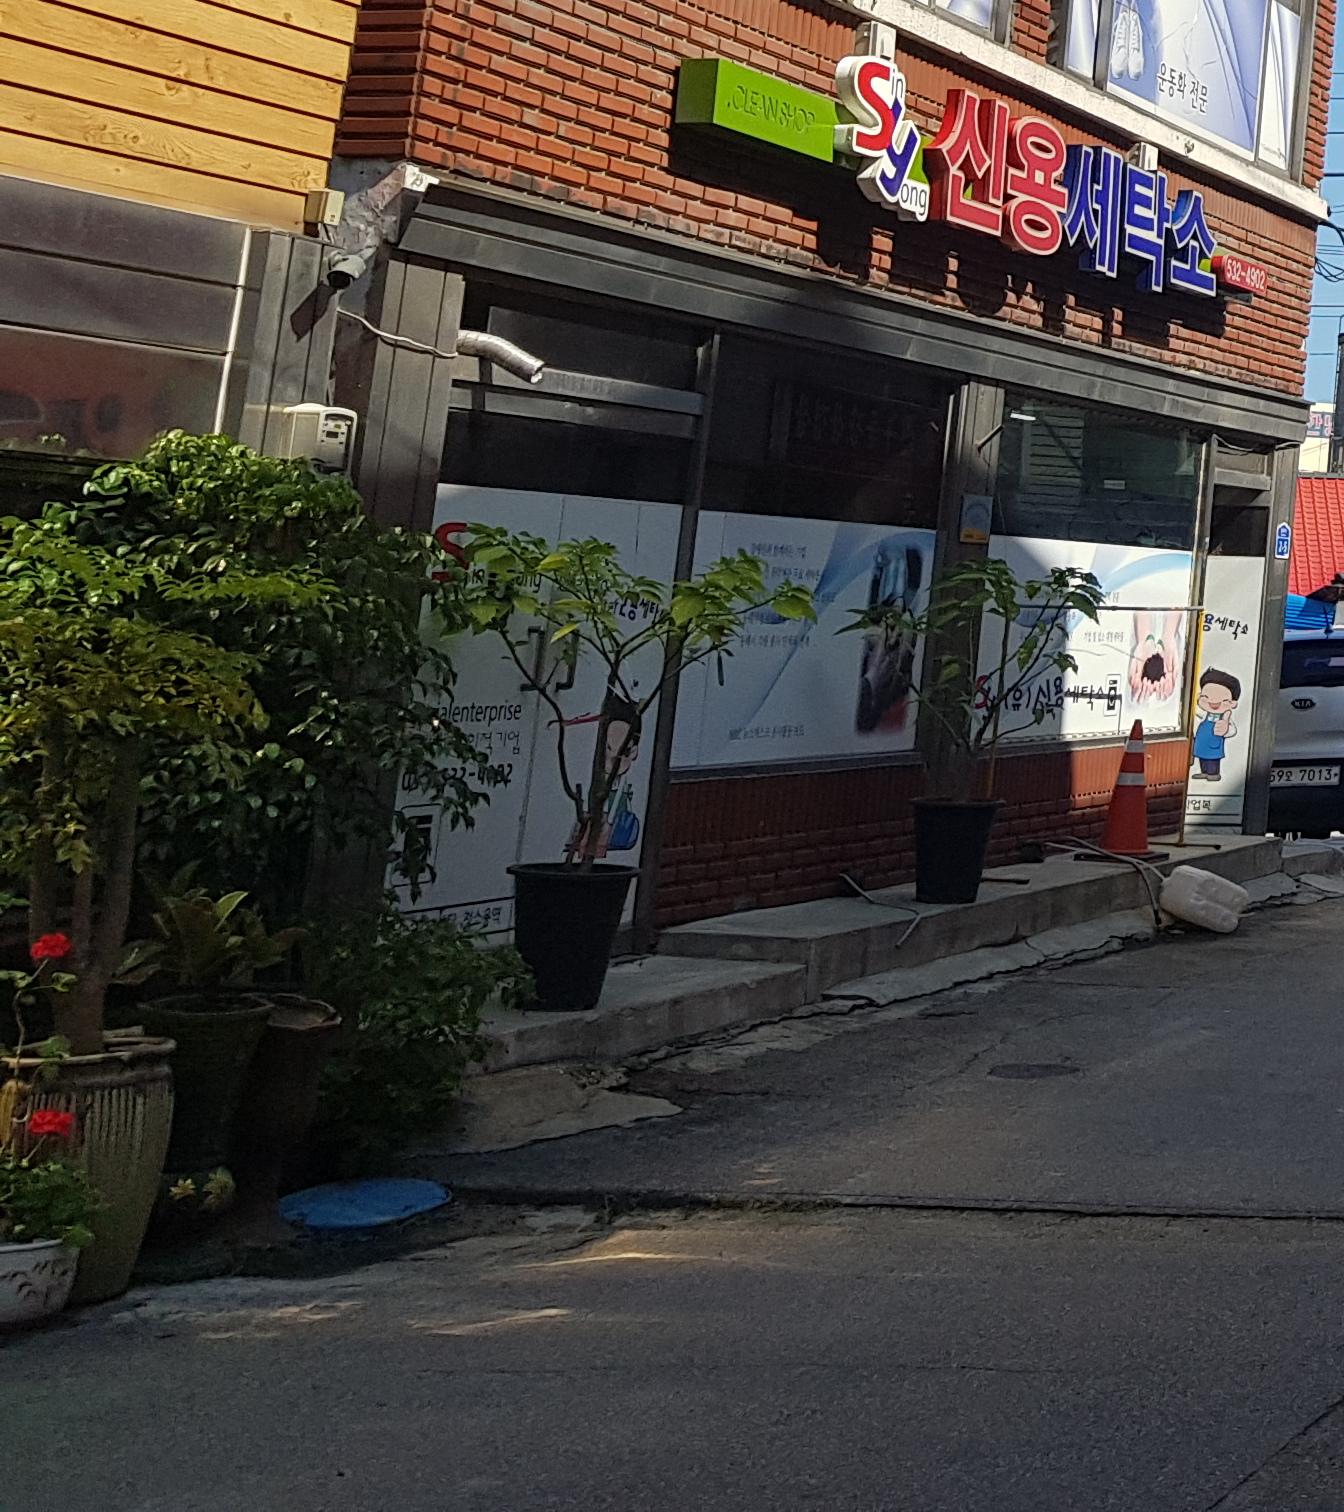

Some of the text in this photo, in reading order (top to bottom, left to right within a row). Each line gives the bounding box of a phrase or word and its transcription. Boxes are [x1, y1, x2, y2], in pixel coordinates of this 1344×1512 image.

[1156, 62, 1209, 114] 운동화 전문
[930, 89, 1218, 298] 신용세탁소
[1225, 254, 1267, 292] 532-4902
[1294, 699, 1313, 709] KIA
[1300, 768, 1333, 782] 7013
